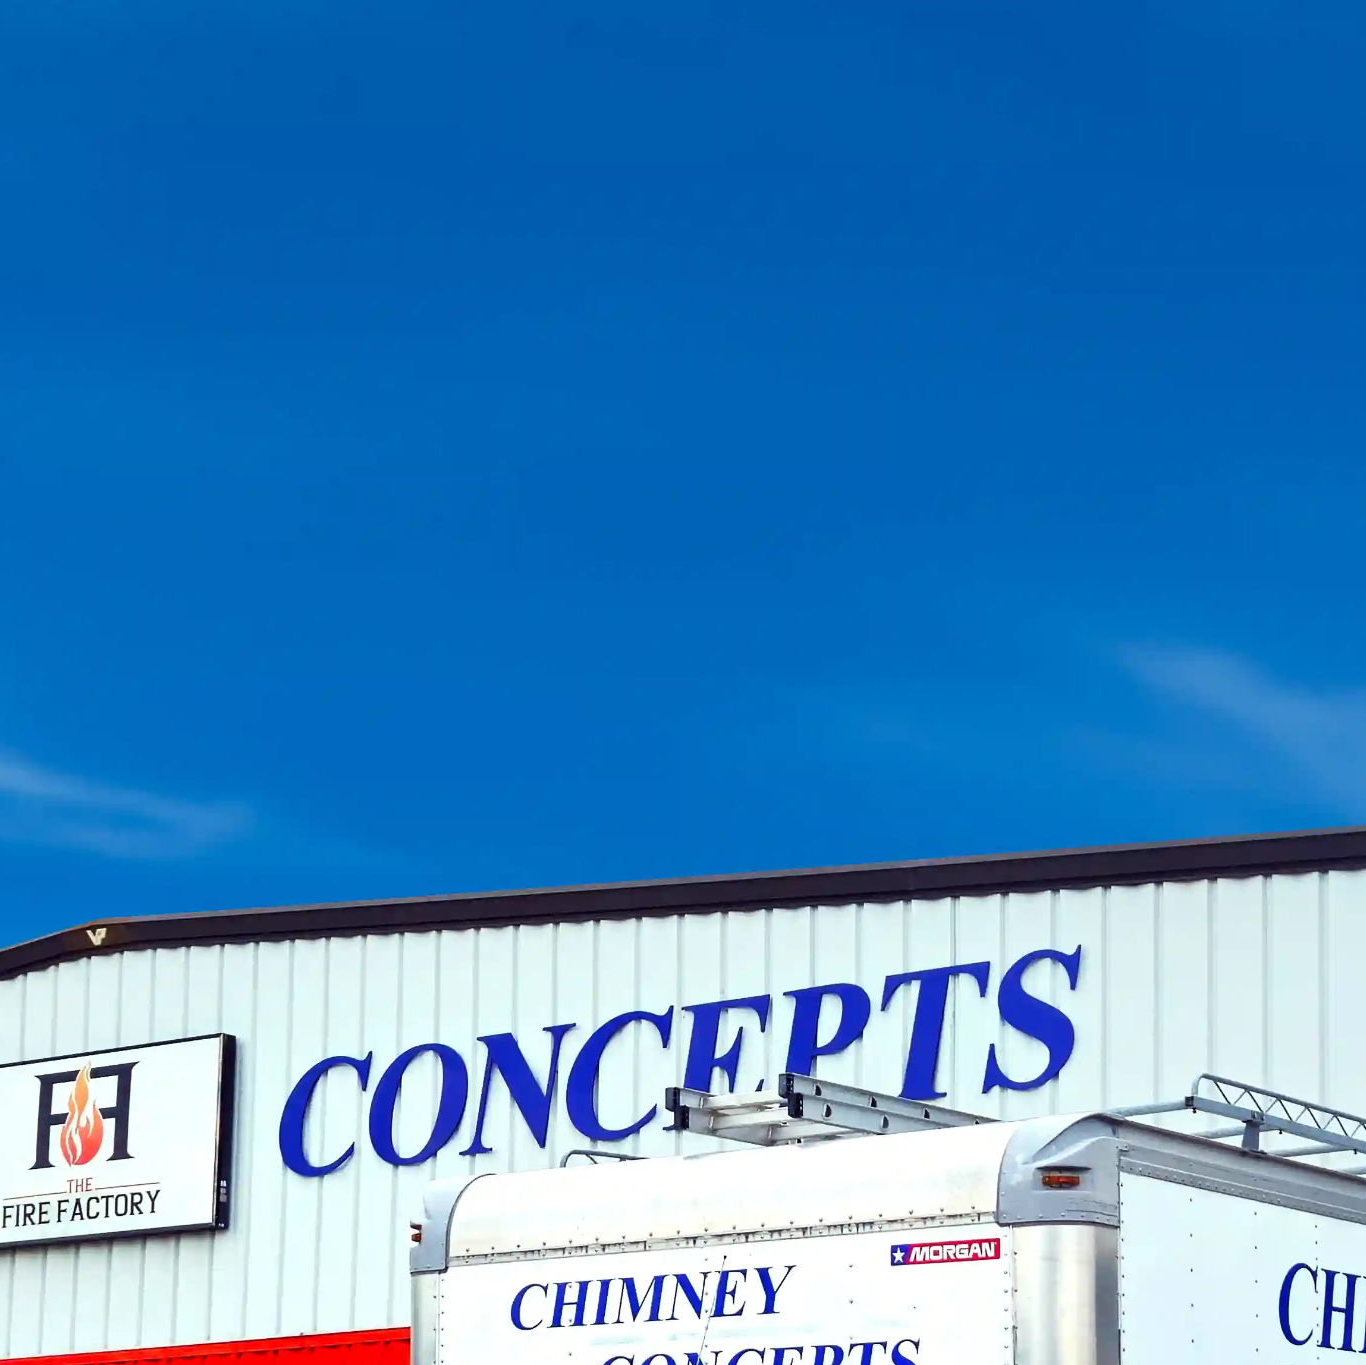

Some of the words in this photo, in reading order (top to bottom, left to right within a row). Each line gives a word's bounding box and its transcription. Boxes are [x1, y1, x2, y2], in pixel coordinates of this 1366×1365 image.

[278, 944, 1082, 1178] CONCEPTS
[66, 1177, 93, 1194] THE
[1, 1201, 51, 1228] FIRE
[56, 1190, 161, 1223] FACTORY
[908, 1242, 996, 1262] MORGAN
[510, 1264, 796, 1331] CHIMNEY
